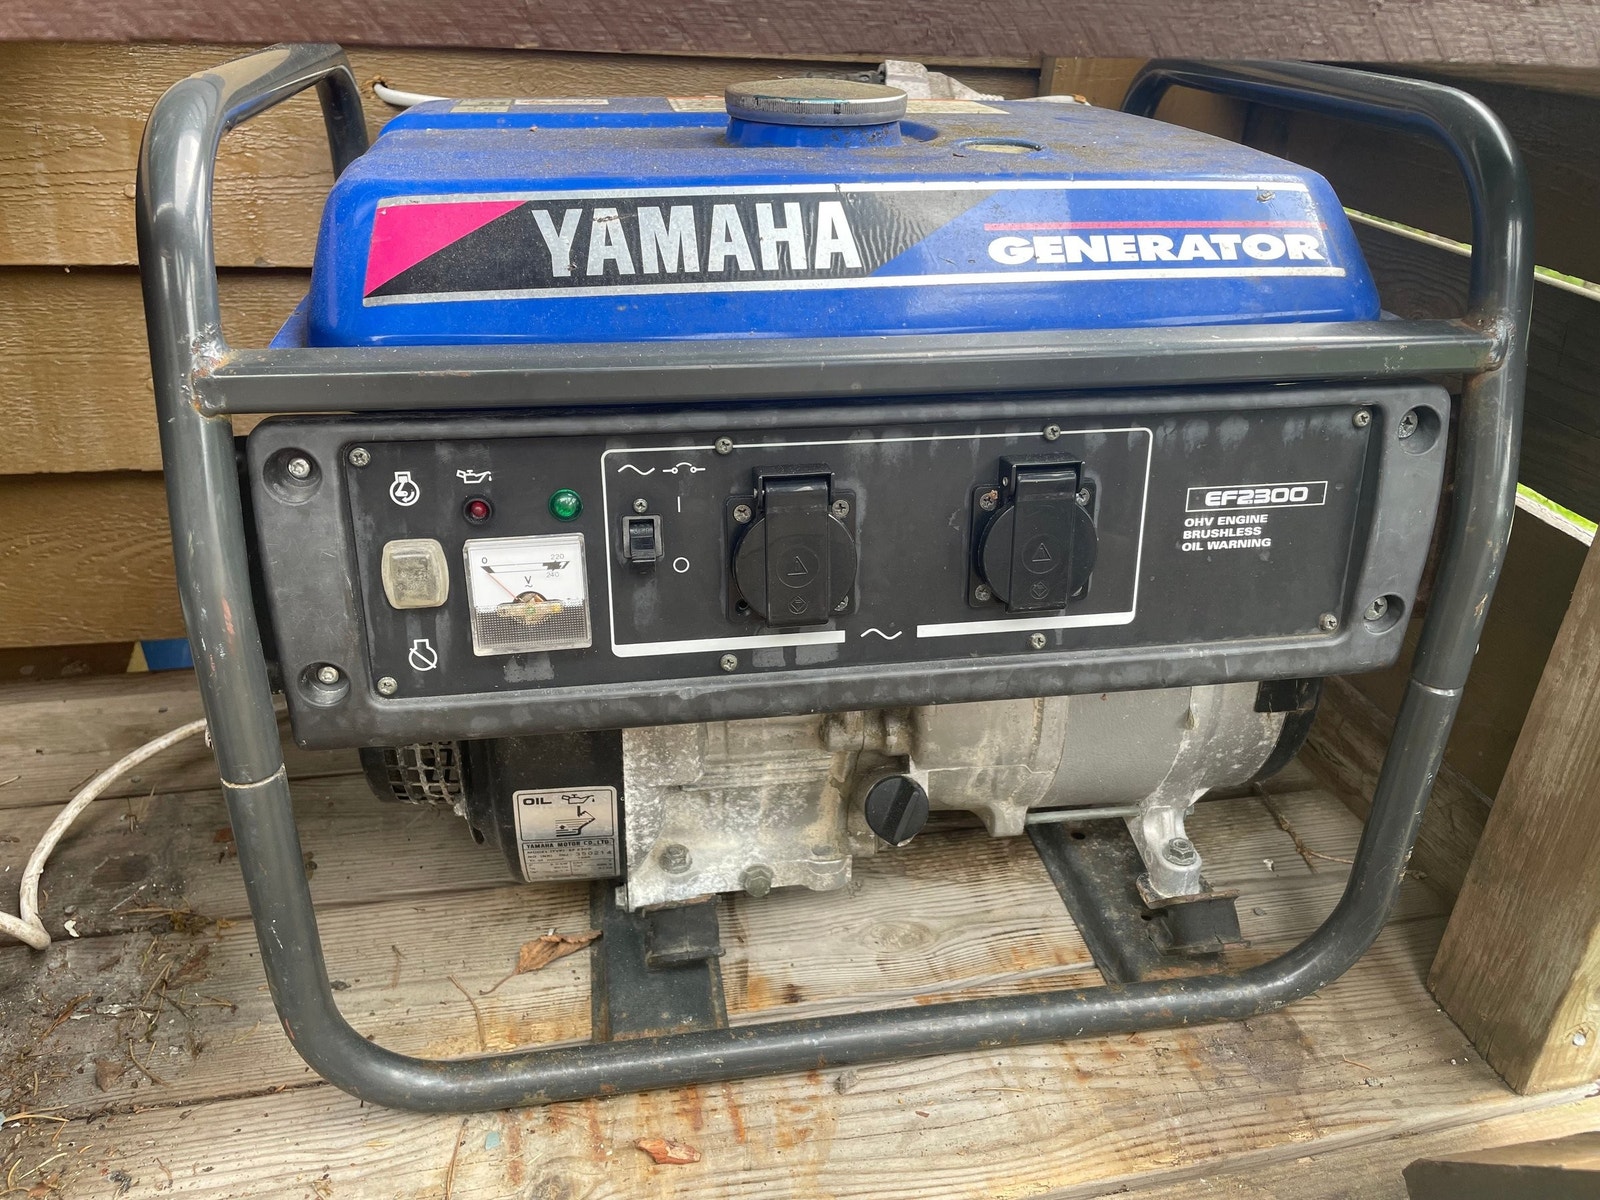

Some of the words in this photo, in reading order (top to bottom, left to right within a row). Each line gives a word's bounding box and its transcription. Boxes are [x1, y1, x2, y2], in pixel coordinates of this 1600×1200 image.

[531, 201, 862, 277] YAMAHA
[988, 233, 1325, 265] GENERATOR
[1205, 487, 1309, 506] EF2300
[1184, 516, 1214, 527] OHV
[1217, 514, 1269, 526] ENGINE
[1183, 527, 1262, 539] BRUSHLESS
[1181, 542, 1204, 552] OIL
[1207, 538, 1272, 550] WARNING
[524, 576, 532, 584] V
[523, 797, 552, 806] OIL
[557, 840, 581, 848] MOTOR
